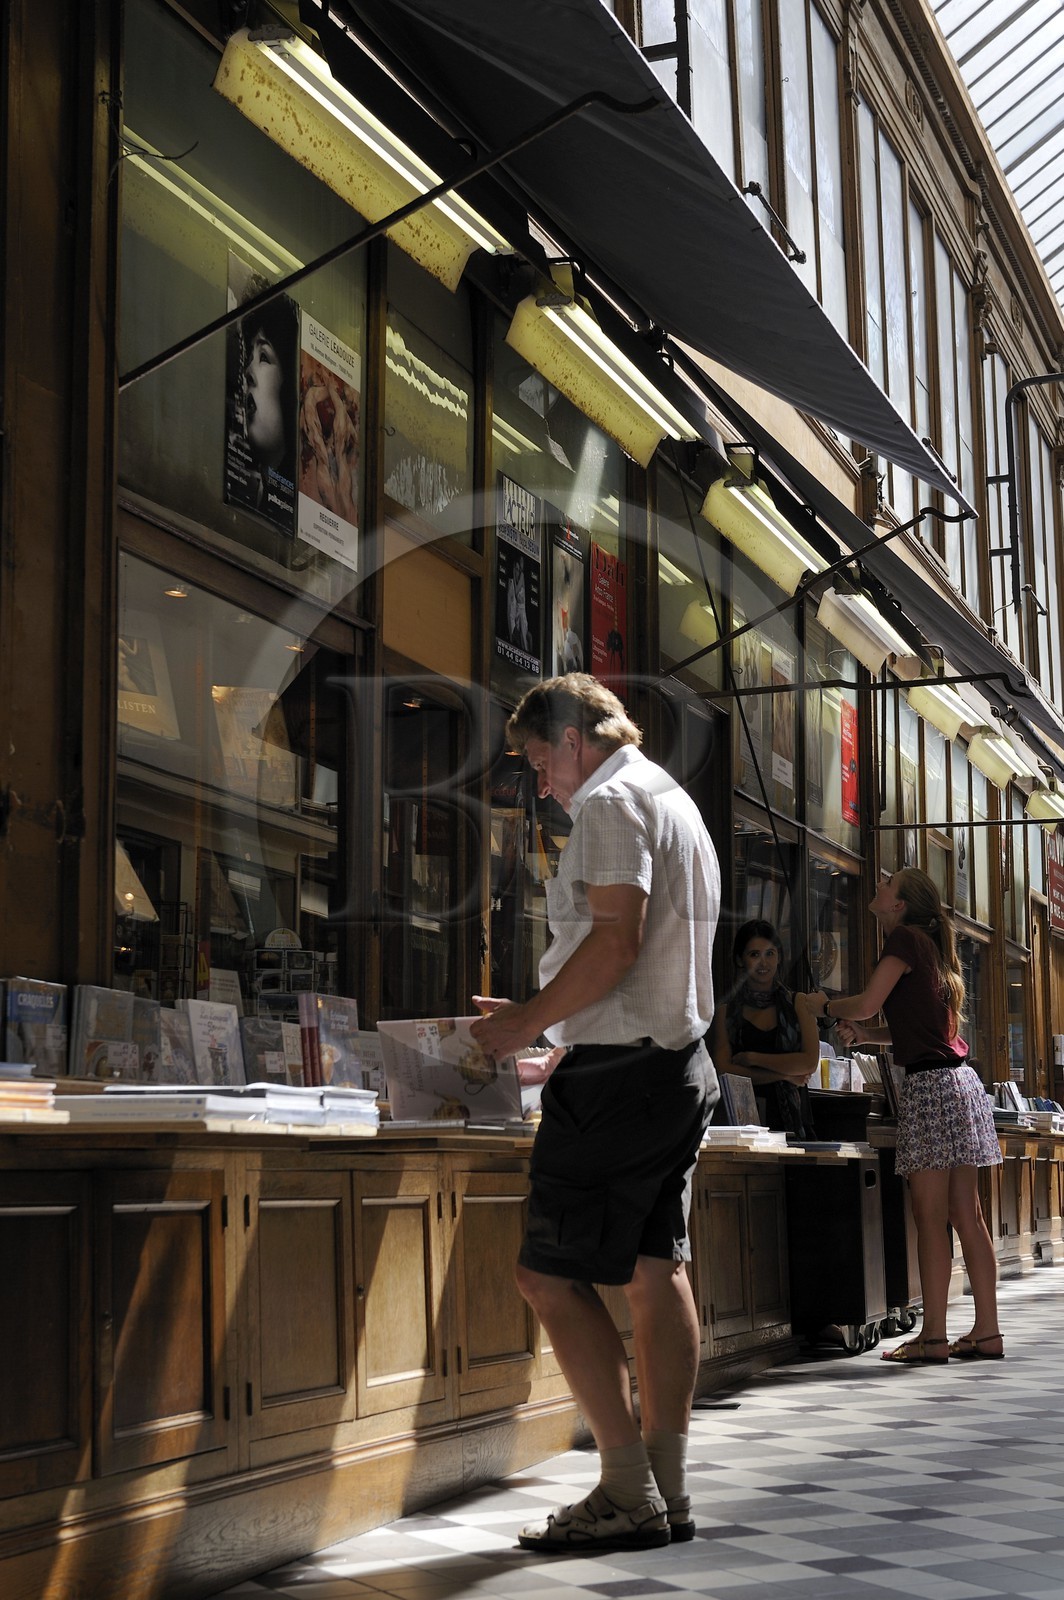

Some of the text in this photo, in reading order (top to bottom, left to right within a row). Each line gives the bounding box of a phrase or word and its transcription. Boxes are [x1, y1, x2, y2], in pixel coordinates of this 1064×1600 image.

[308, 323, 330, 348] GALERIE
[497, 645, 505, 656] 01
[505, 649, 514, 660] 44
[523, 659, 531, 669] 13
